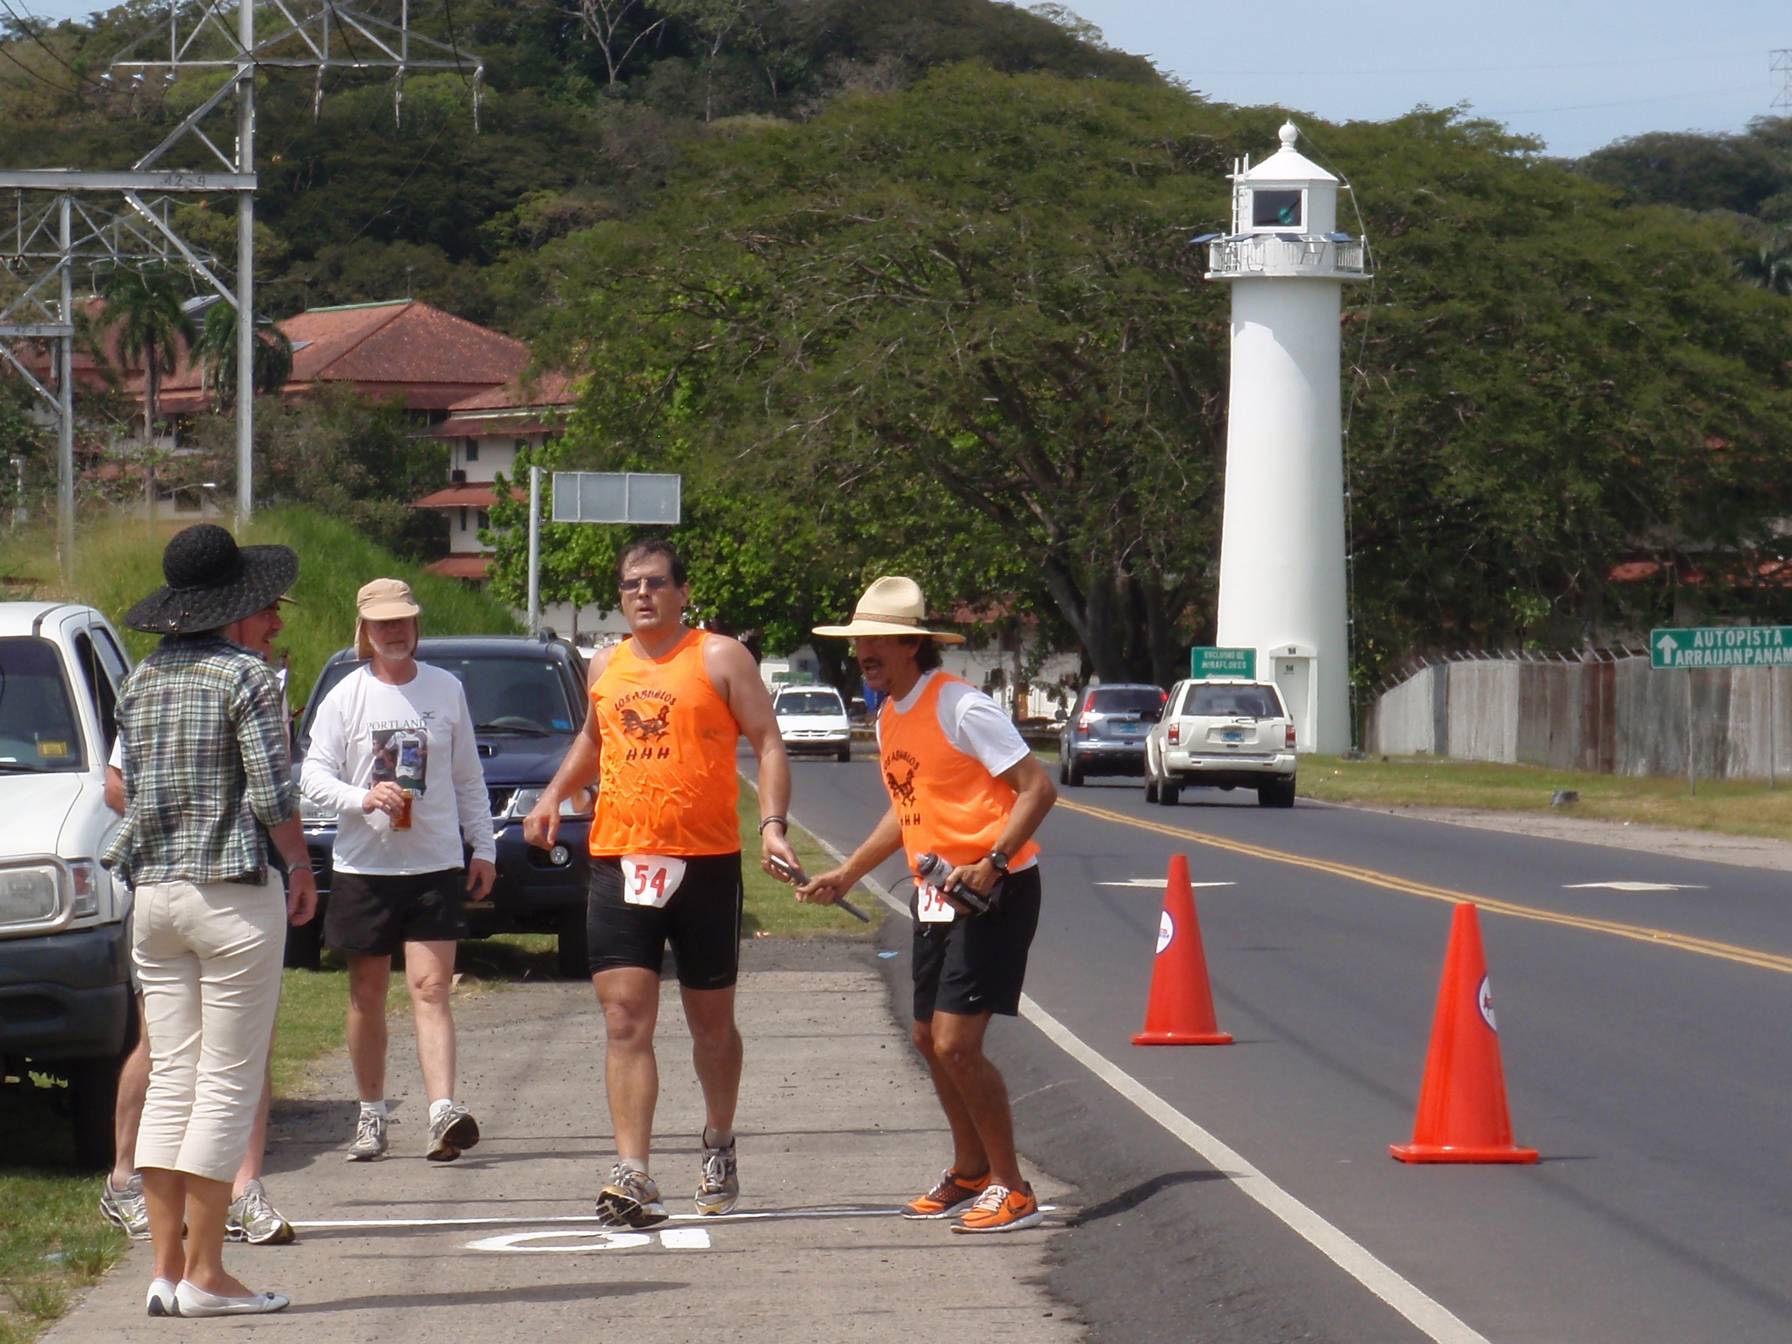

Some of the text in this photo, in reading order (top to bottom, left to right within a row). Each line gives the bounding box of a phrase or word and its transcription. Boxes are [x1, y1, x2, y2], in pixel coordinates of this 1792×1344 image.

[1694, 630, 1783, 648] AUTOPISTA
[1202, 660, 1247, 670] MIRAFLORES
[1675, 648, 1744, 666] ARRAIJAN
[615, 694, 631, 711] LOS
[368, 719, 428, 731] PORTLAND
[634, 864, 667, 898] 54
